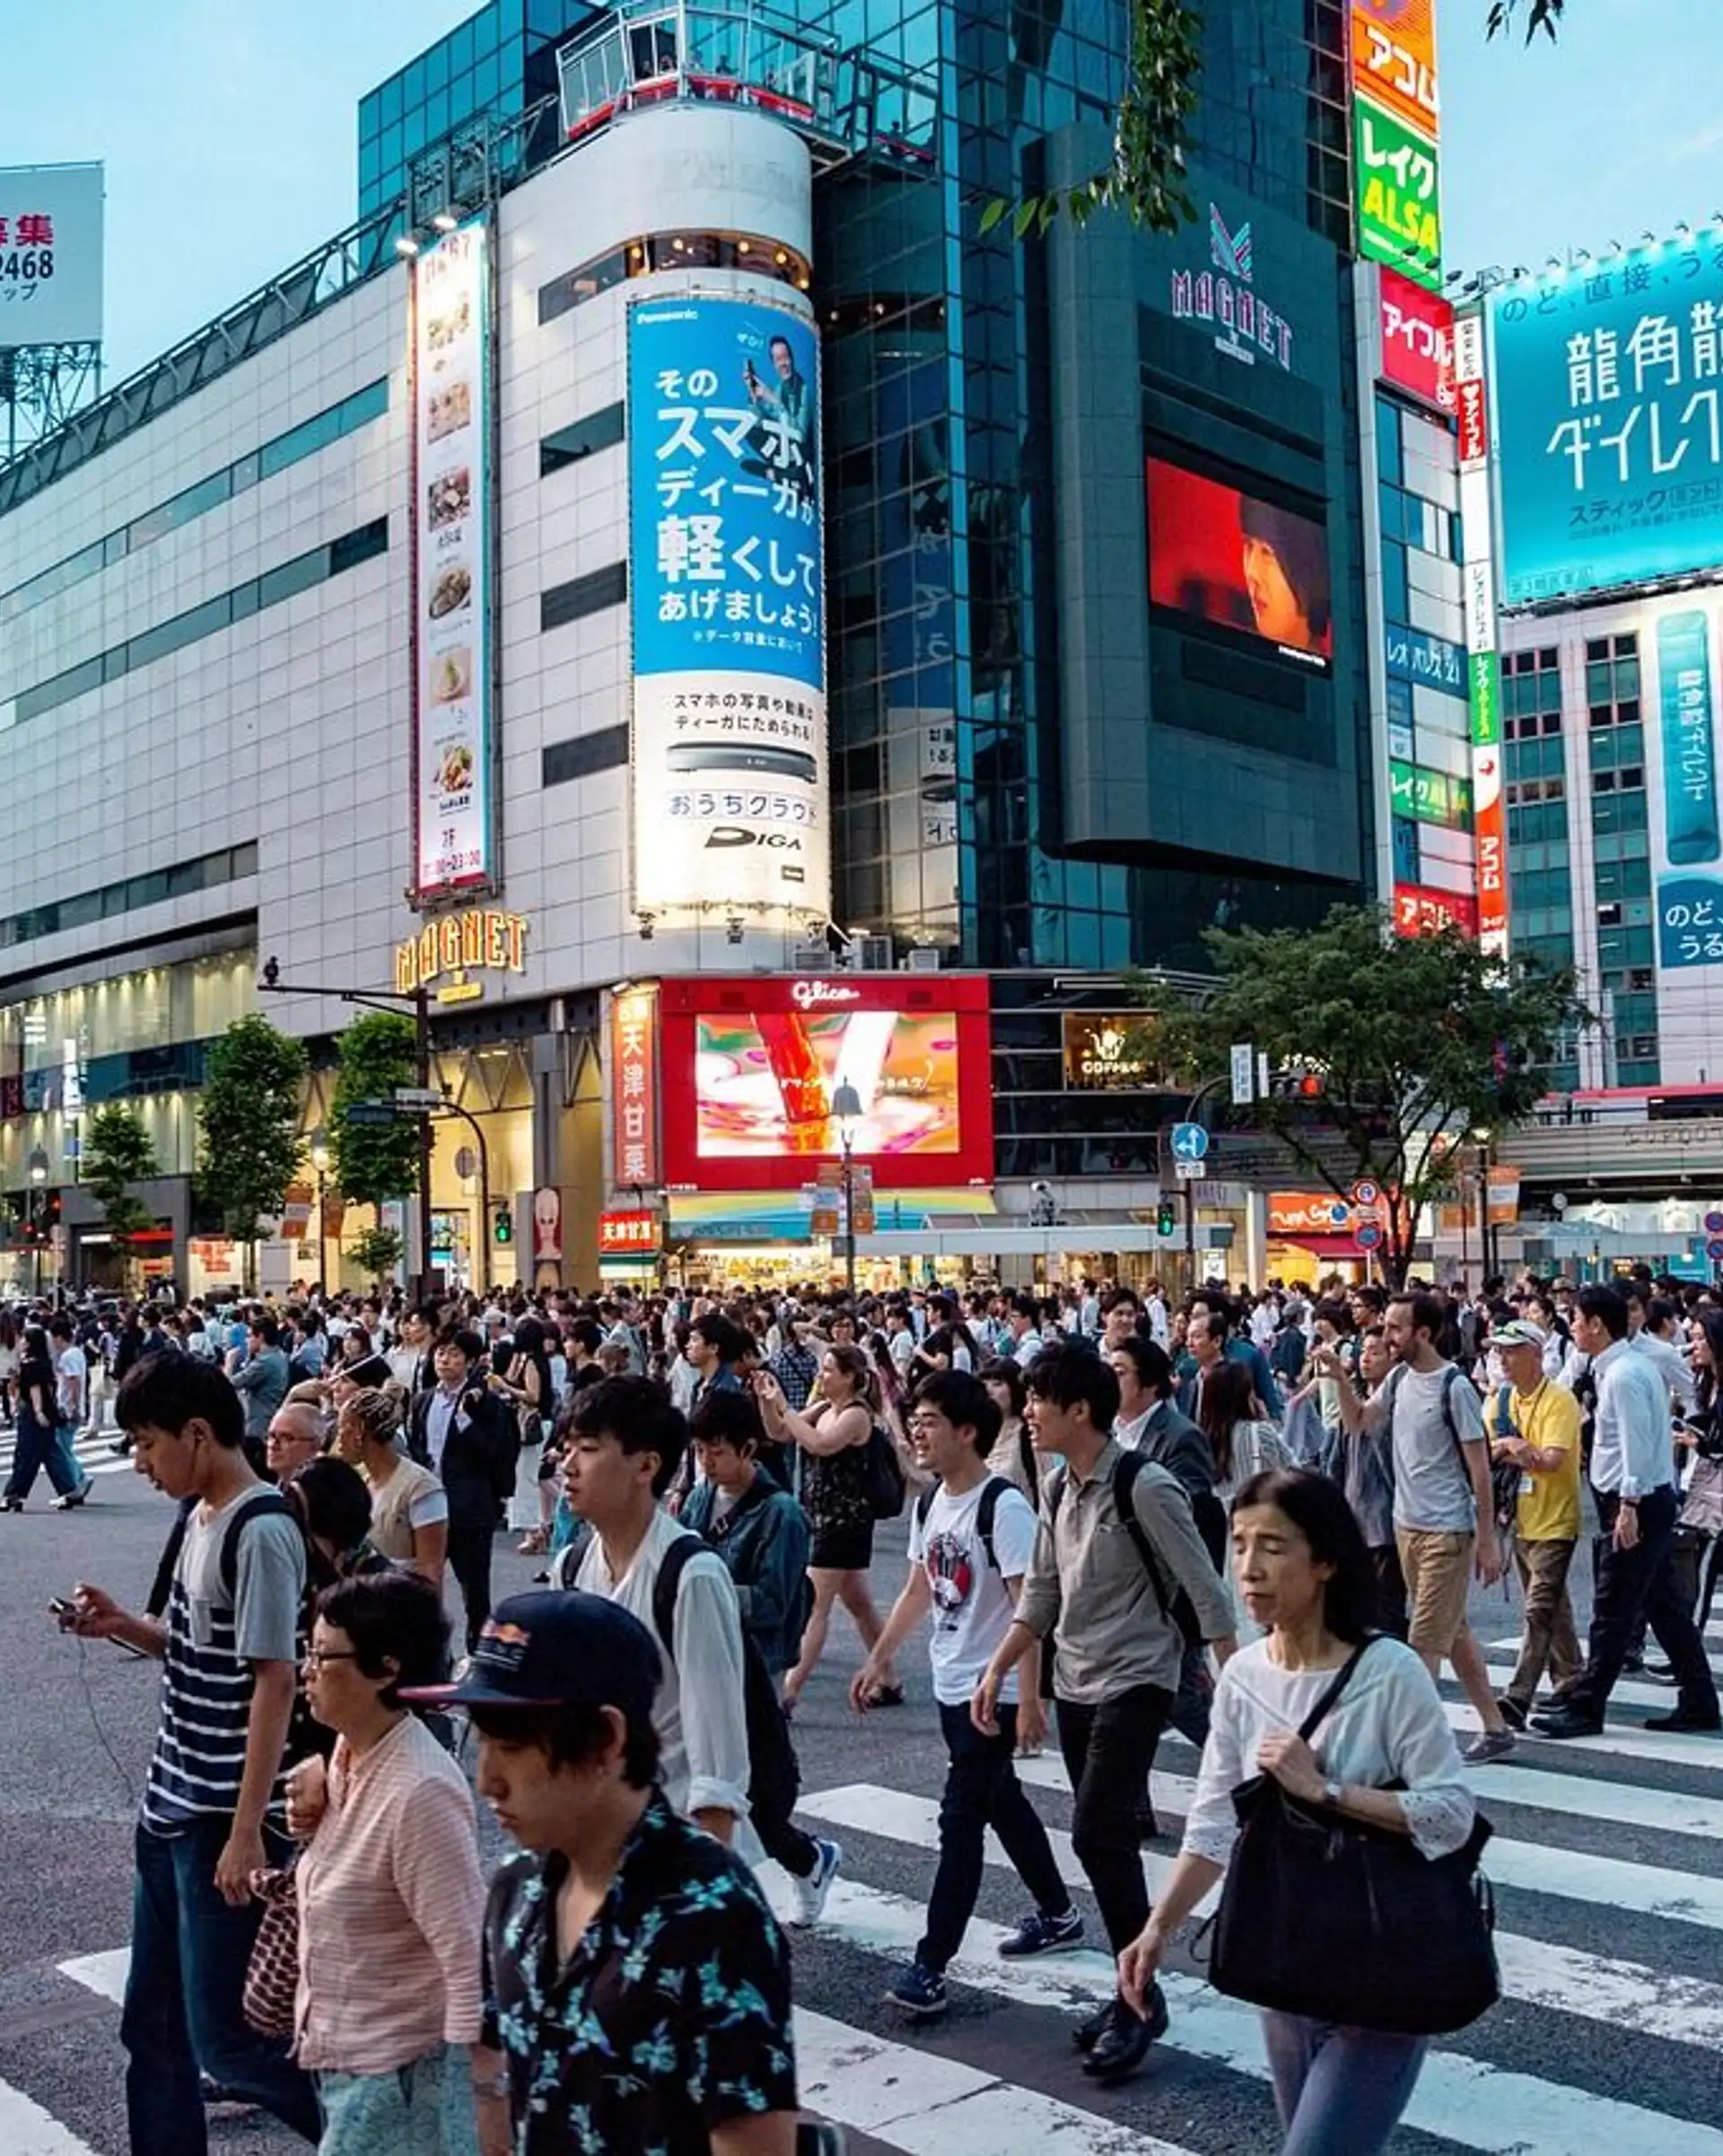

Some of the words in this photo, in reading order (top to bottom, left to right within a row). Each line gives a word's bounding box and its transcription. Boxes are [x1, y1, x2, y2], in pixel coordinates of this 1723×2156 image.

[1367, 24, 1440, 112] アコム
[1362, 118, 1434, 200] レイク
[0, 214, 54, 248] 集
[1363, 177, 1439, 259] ALSA
[1171, 268, 1293, 371] MAGNET
[1382, 300, 1453, 366] アイフル
[655, 369, 718, 398] その
[657, 465, 815, 528] ディーガが
[1569, 490, 1666, 528] スティック
[657, 513, 816, 598] 軽くして
[704, 826, 802, 851] DIGA
[1481, 835, 1500, 889] アコム
[395, 910, 529, 994] MAGNET
